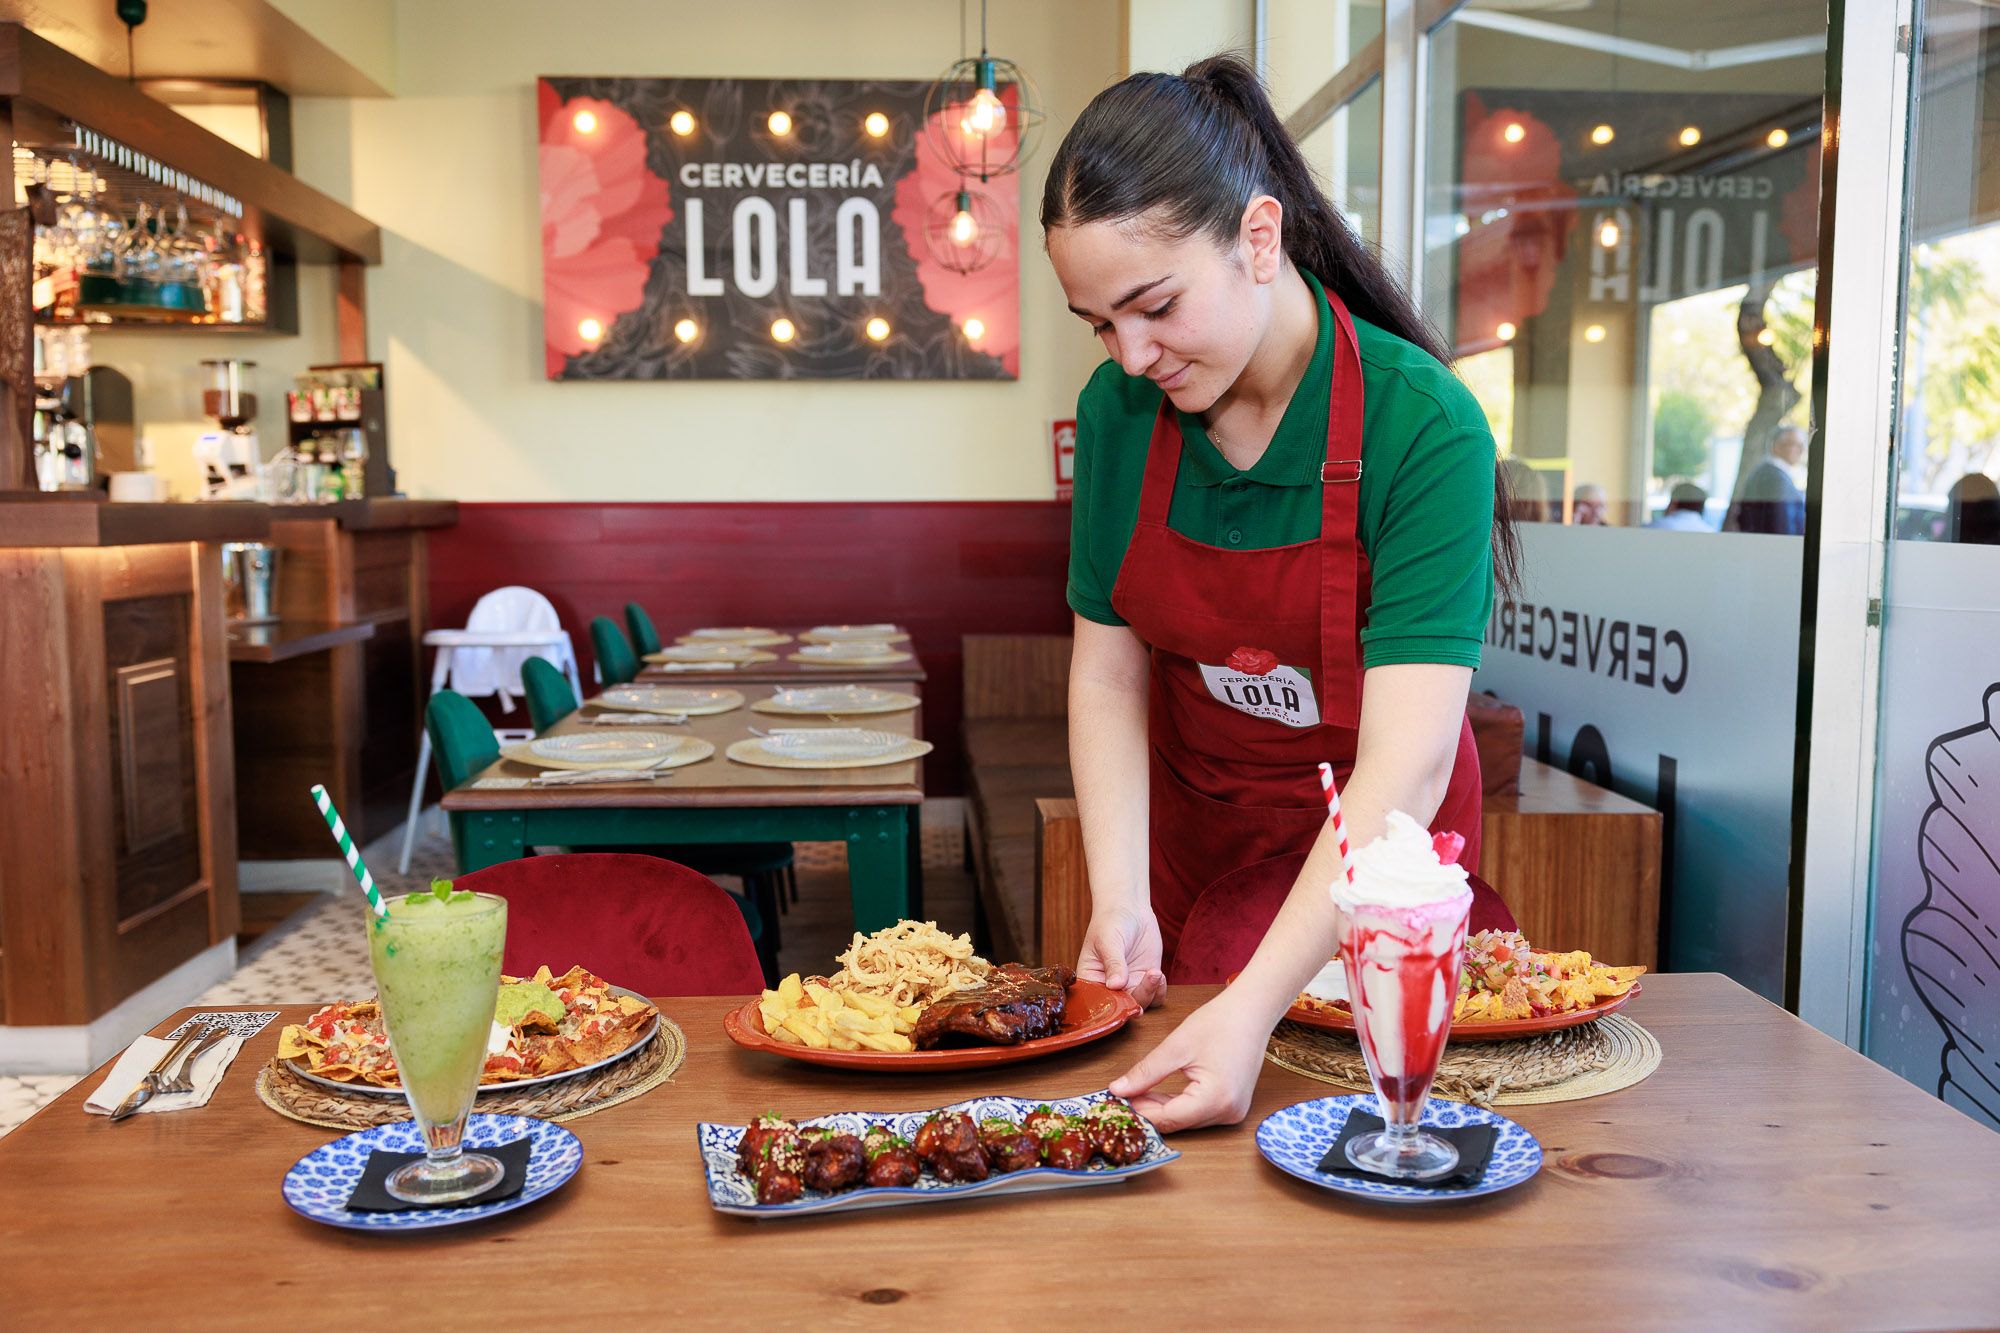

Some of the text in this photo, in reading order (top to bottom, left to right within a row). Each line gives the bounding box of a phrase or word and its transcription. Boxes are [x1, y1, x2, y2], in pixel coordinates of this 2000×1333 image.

[679, 158, 884, 188] CERVECERÍA
[684, 195, 881, 298] LOLA
[1219, 675, 1296, 687] CERVECERÍA
[1223, 683, 1301, 713] LOLA
[1246, 706, 1289, 718] JEREZ
